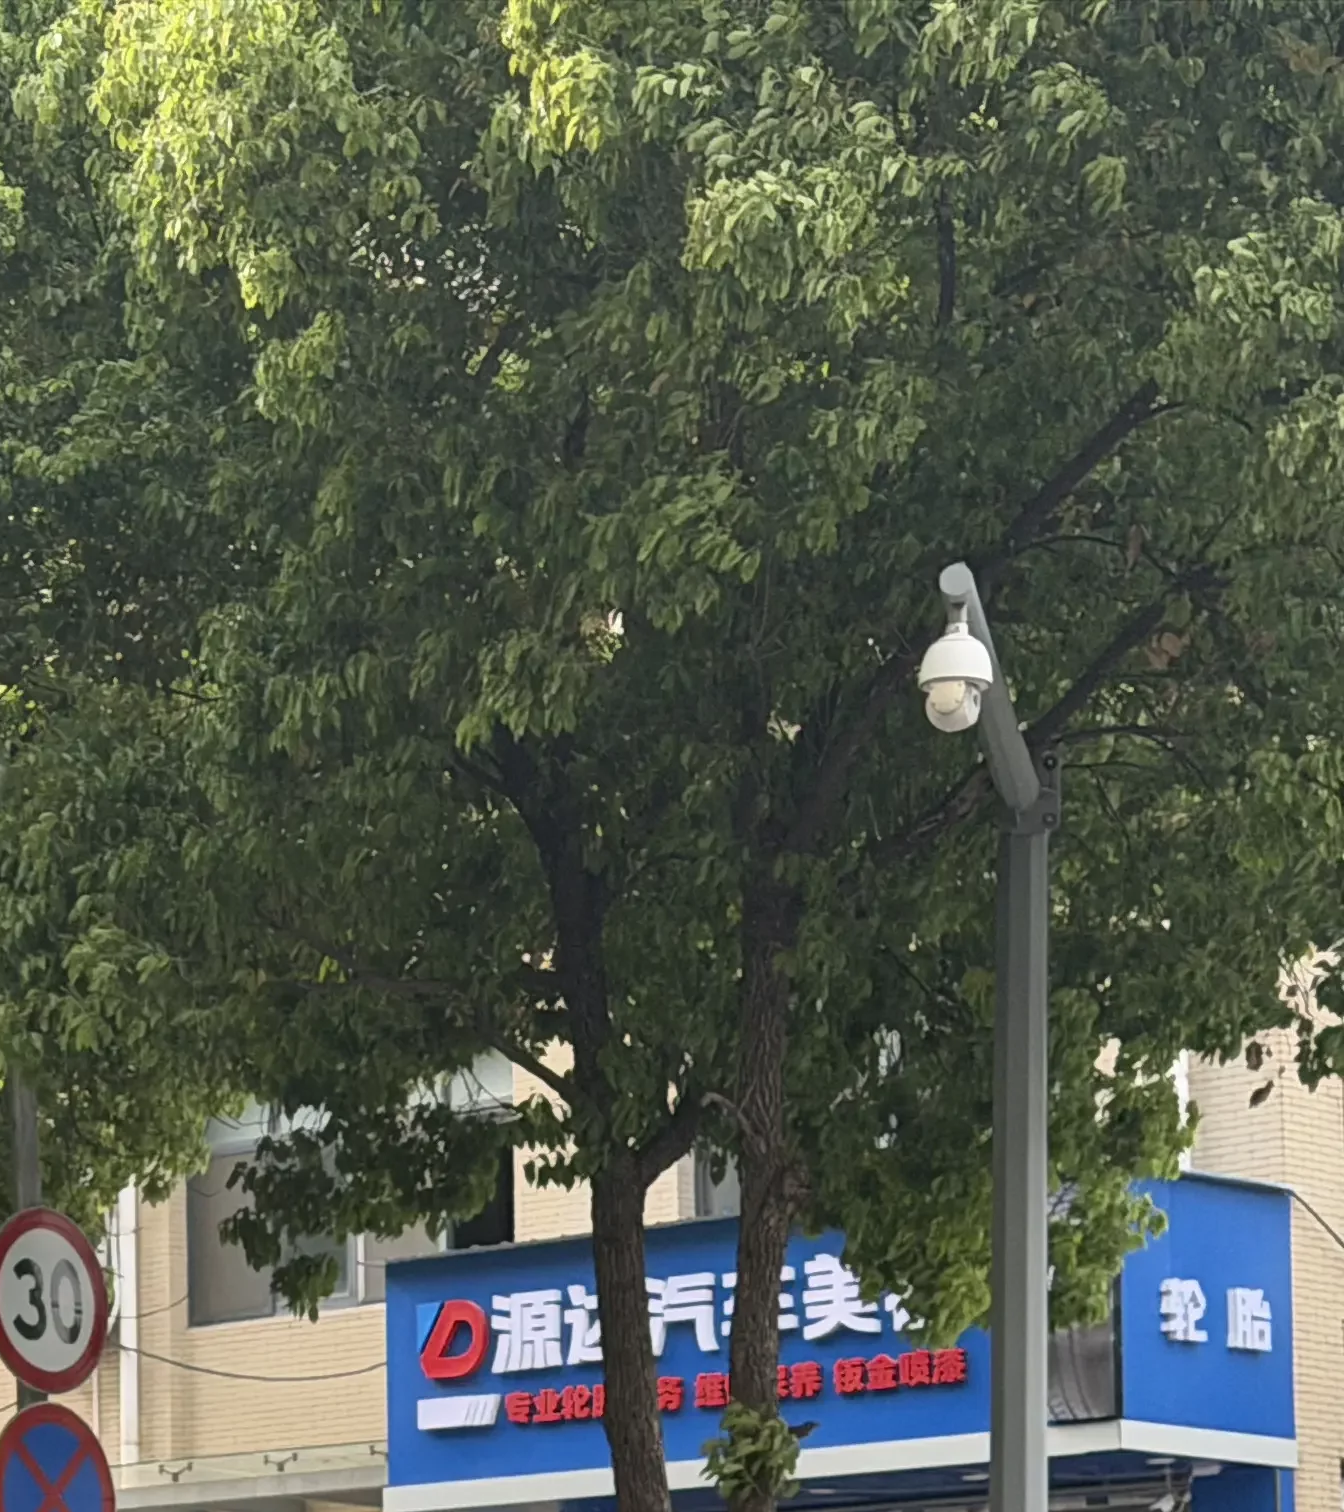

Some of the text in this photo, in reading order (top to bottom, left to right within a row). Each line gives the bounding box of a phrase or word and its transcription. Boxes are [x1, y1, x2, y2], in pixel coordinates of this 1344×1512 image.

[12, 1257, 83, 1345] 30
[1159, 1277, 1273, 1353] 轮胎
[504, 1348, 968, 1424] 专业轮务 维养 钣金喷漆
